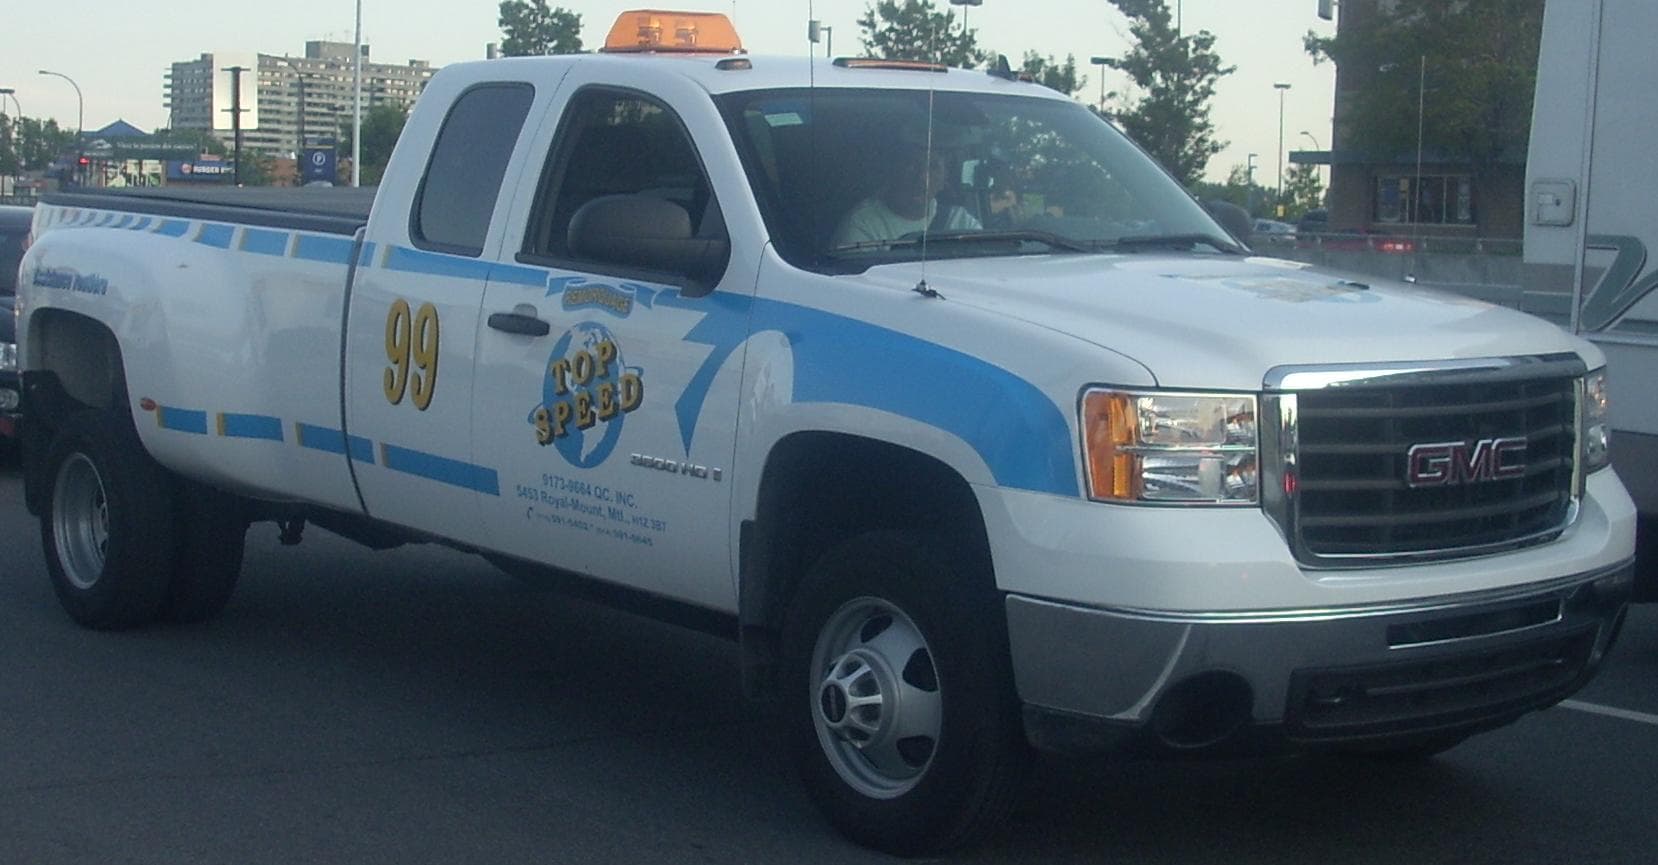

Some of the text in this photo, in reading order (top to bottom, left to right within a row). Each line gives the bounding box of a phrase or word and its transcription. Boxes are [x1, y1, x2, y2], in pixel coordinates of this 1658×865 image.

[383, 298, 440, 412] 99
[550, 340, 618, 396] TOP
[535, 374, 644, 447] SPEED
[1407, 437, 1528, 488] GMC
[615, 490, 638, 509] INC.
